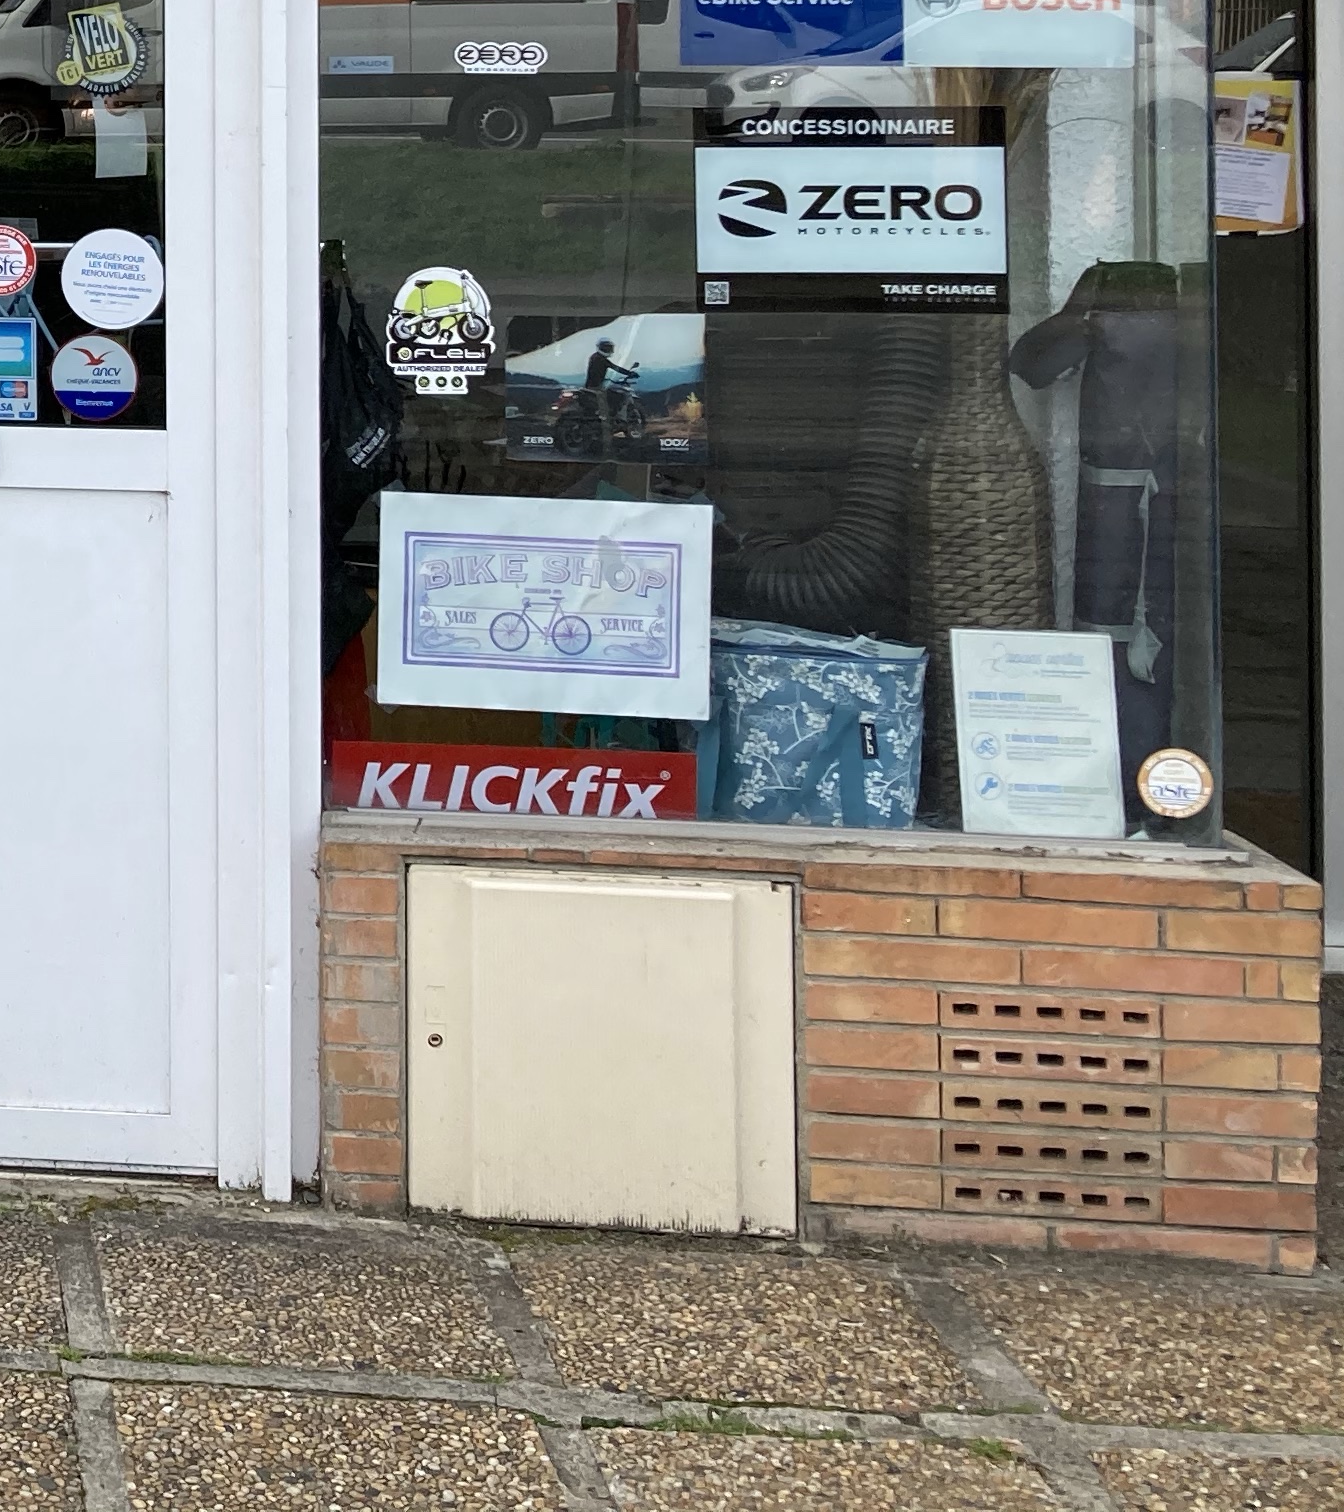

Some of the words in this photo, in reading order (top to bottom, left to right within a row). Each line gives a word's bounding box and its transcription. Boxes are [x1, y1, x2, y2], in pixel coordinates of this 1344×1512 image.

[85, 49, 123, 70] VERT
[459, 45, 544, 66] ZERO
[741, 118, 955, 137] CONCESSIONNAIRE
[798, 183, 983, 222] ZERO
[881, 284, 924, 295] TAKE
[925, 284, 997, 296] CHARGE
[523, 436, 554, 445] ZERO
[420, 553, 529, 591] BIKE
[541, 555, 668, 599] SHOP
[444, 610, 477, 624] SALES
[600, 617, 644, 634] SERVICE
